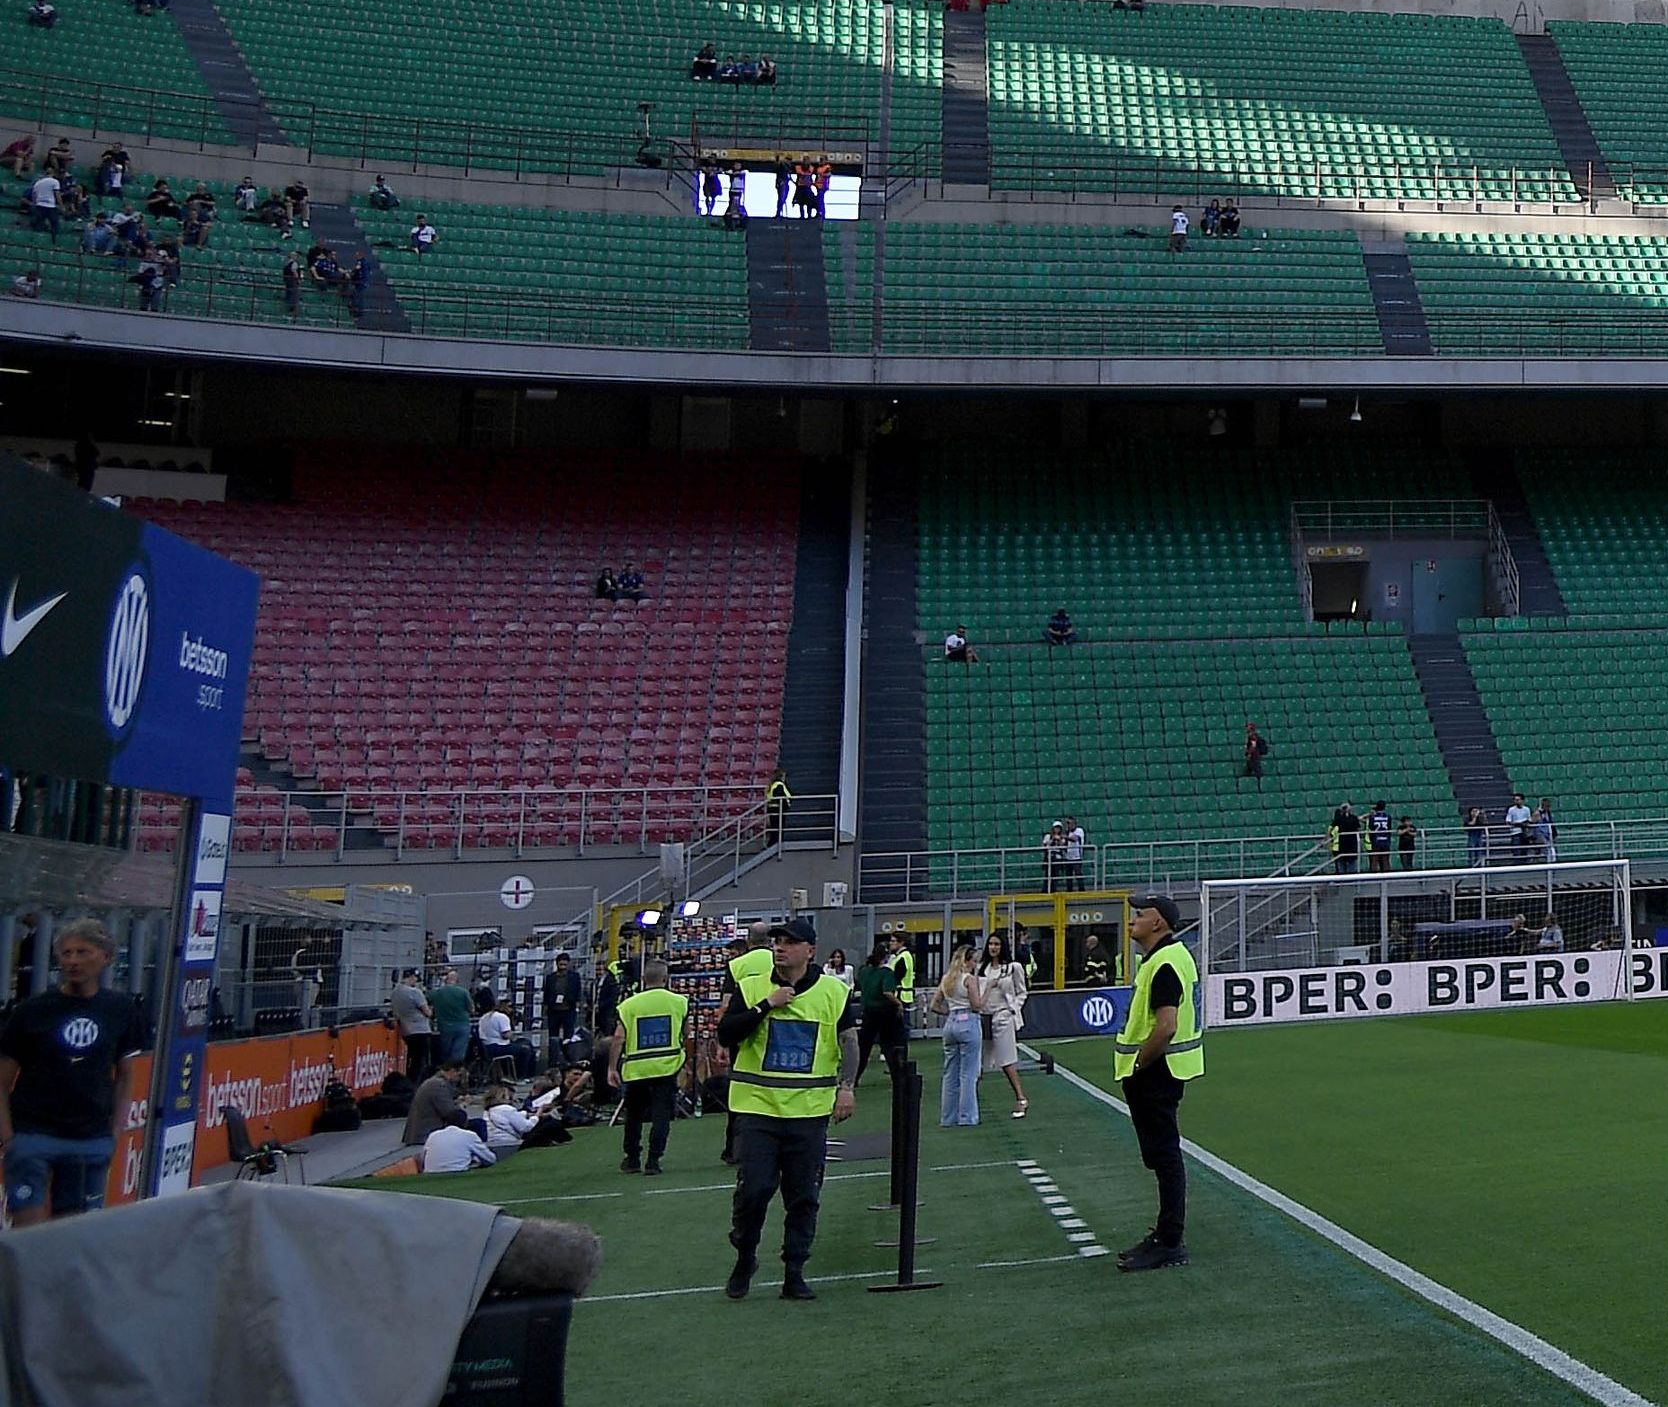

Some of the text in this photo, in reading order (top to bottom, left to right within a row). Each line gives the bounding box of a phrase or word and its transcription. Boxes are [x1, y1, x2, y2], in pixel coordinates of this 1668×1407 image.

[180, 631, 228, 680] betsson
[1224, 968, 1393, 1020] BPER:
[1428, 957, 1591, 1007] BPER:
